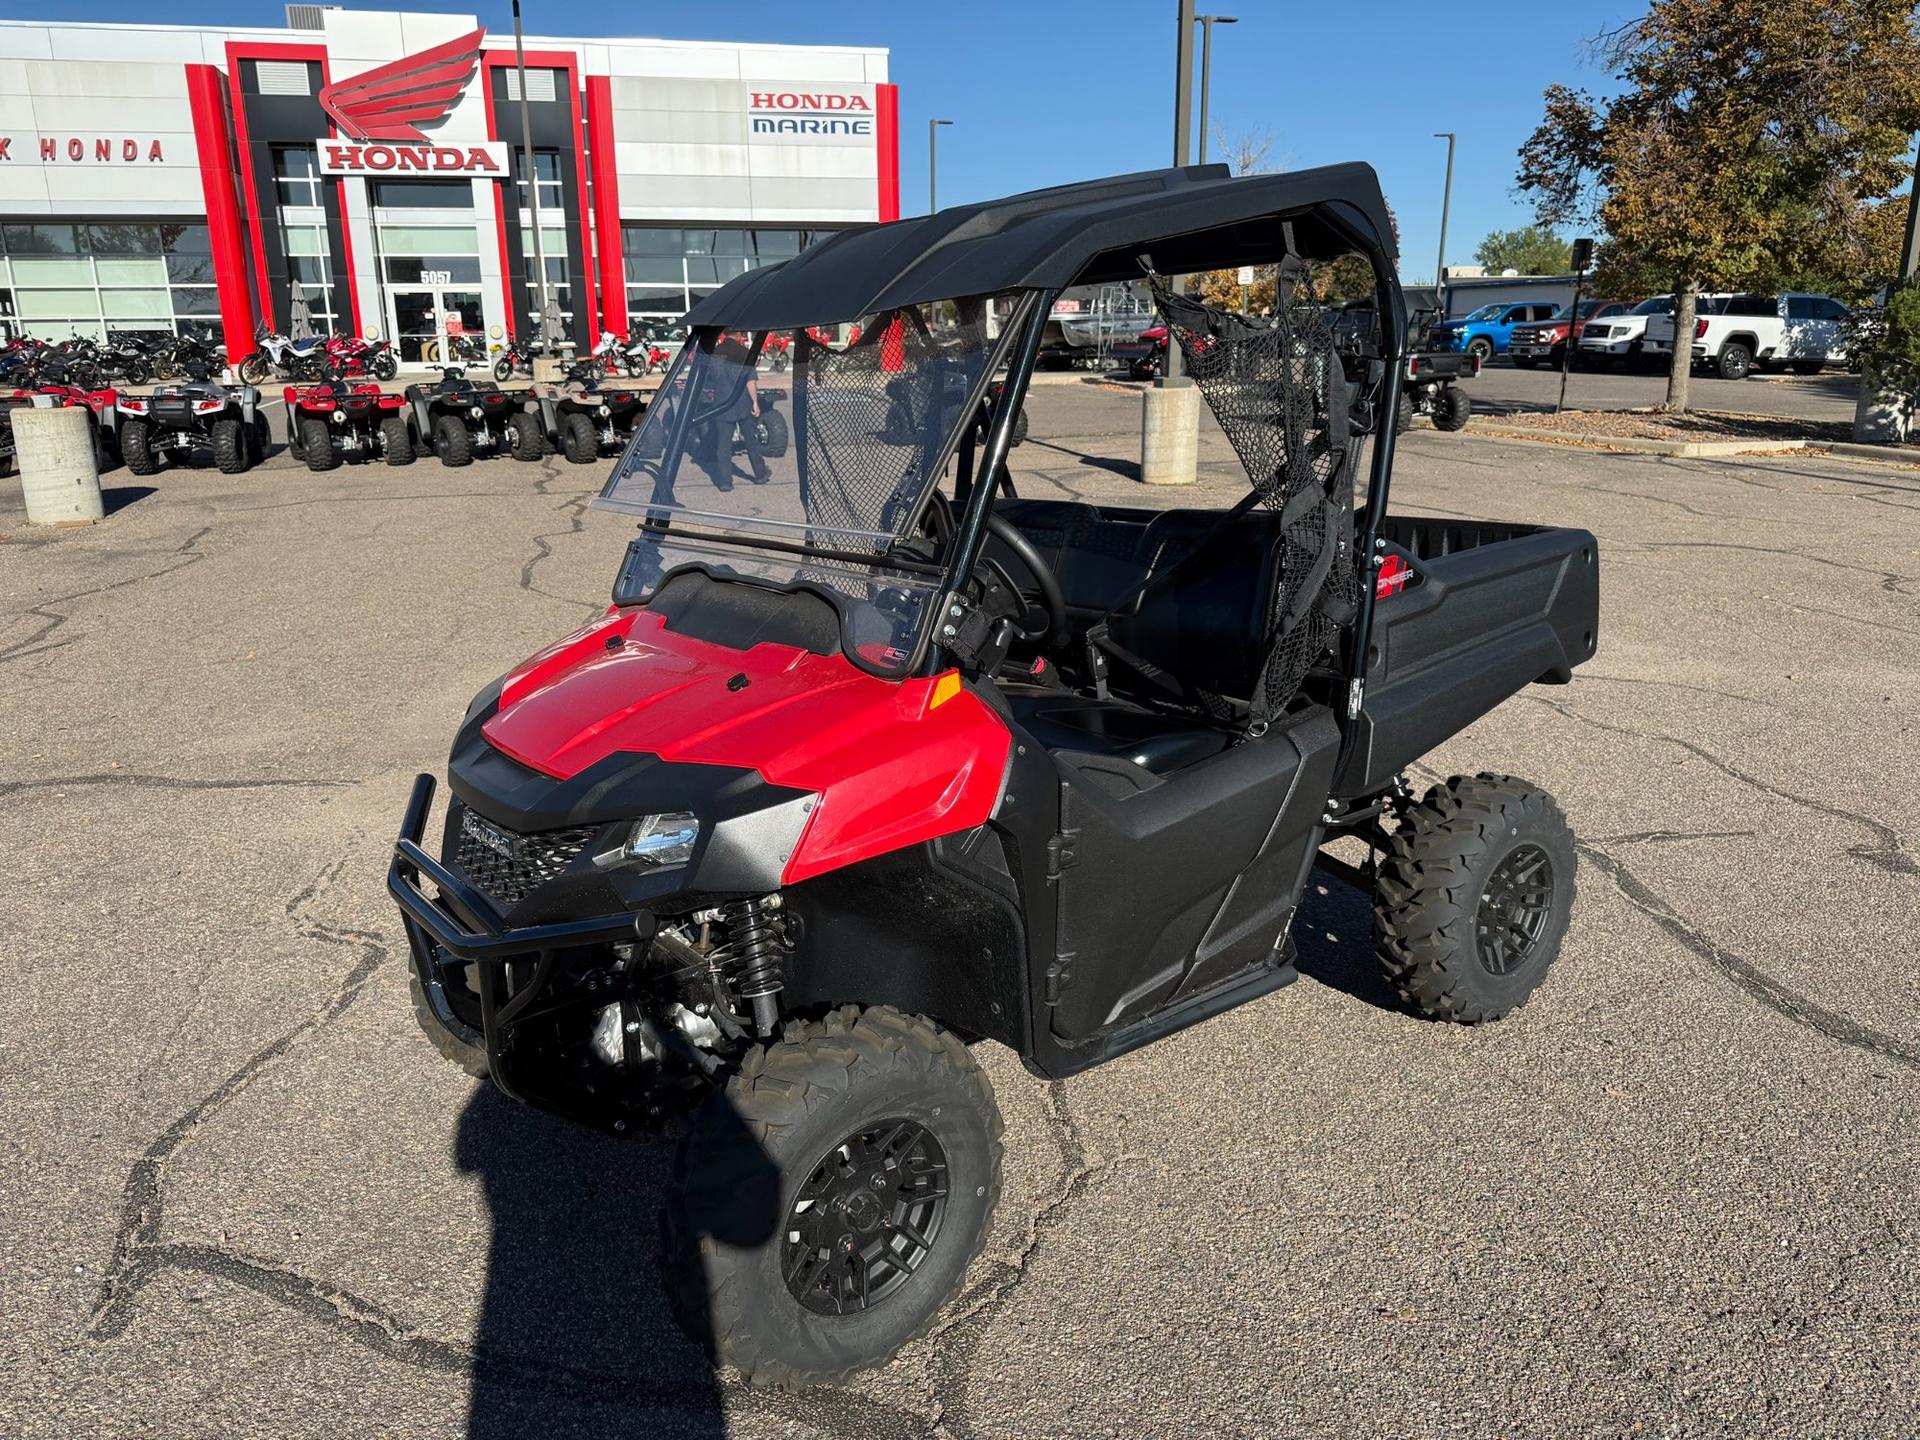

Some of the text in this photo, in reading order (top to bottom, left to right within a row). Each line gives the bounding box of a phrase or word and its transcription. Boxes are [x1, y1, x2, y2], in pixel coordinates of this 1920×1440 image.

[750, 93, 872, 110] HONDA
[40, 138, 164, 162] HONDA
[325, 146, 500, 171] HONDA
[420, 270, 451, 284] 5057
[1377, 569, 1414, 589] ONEER
